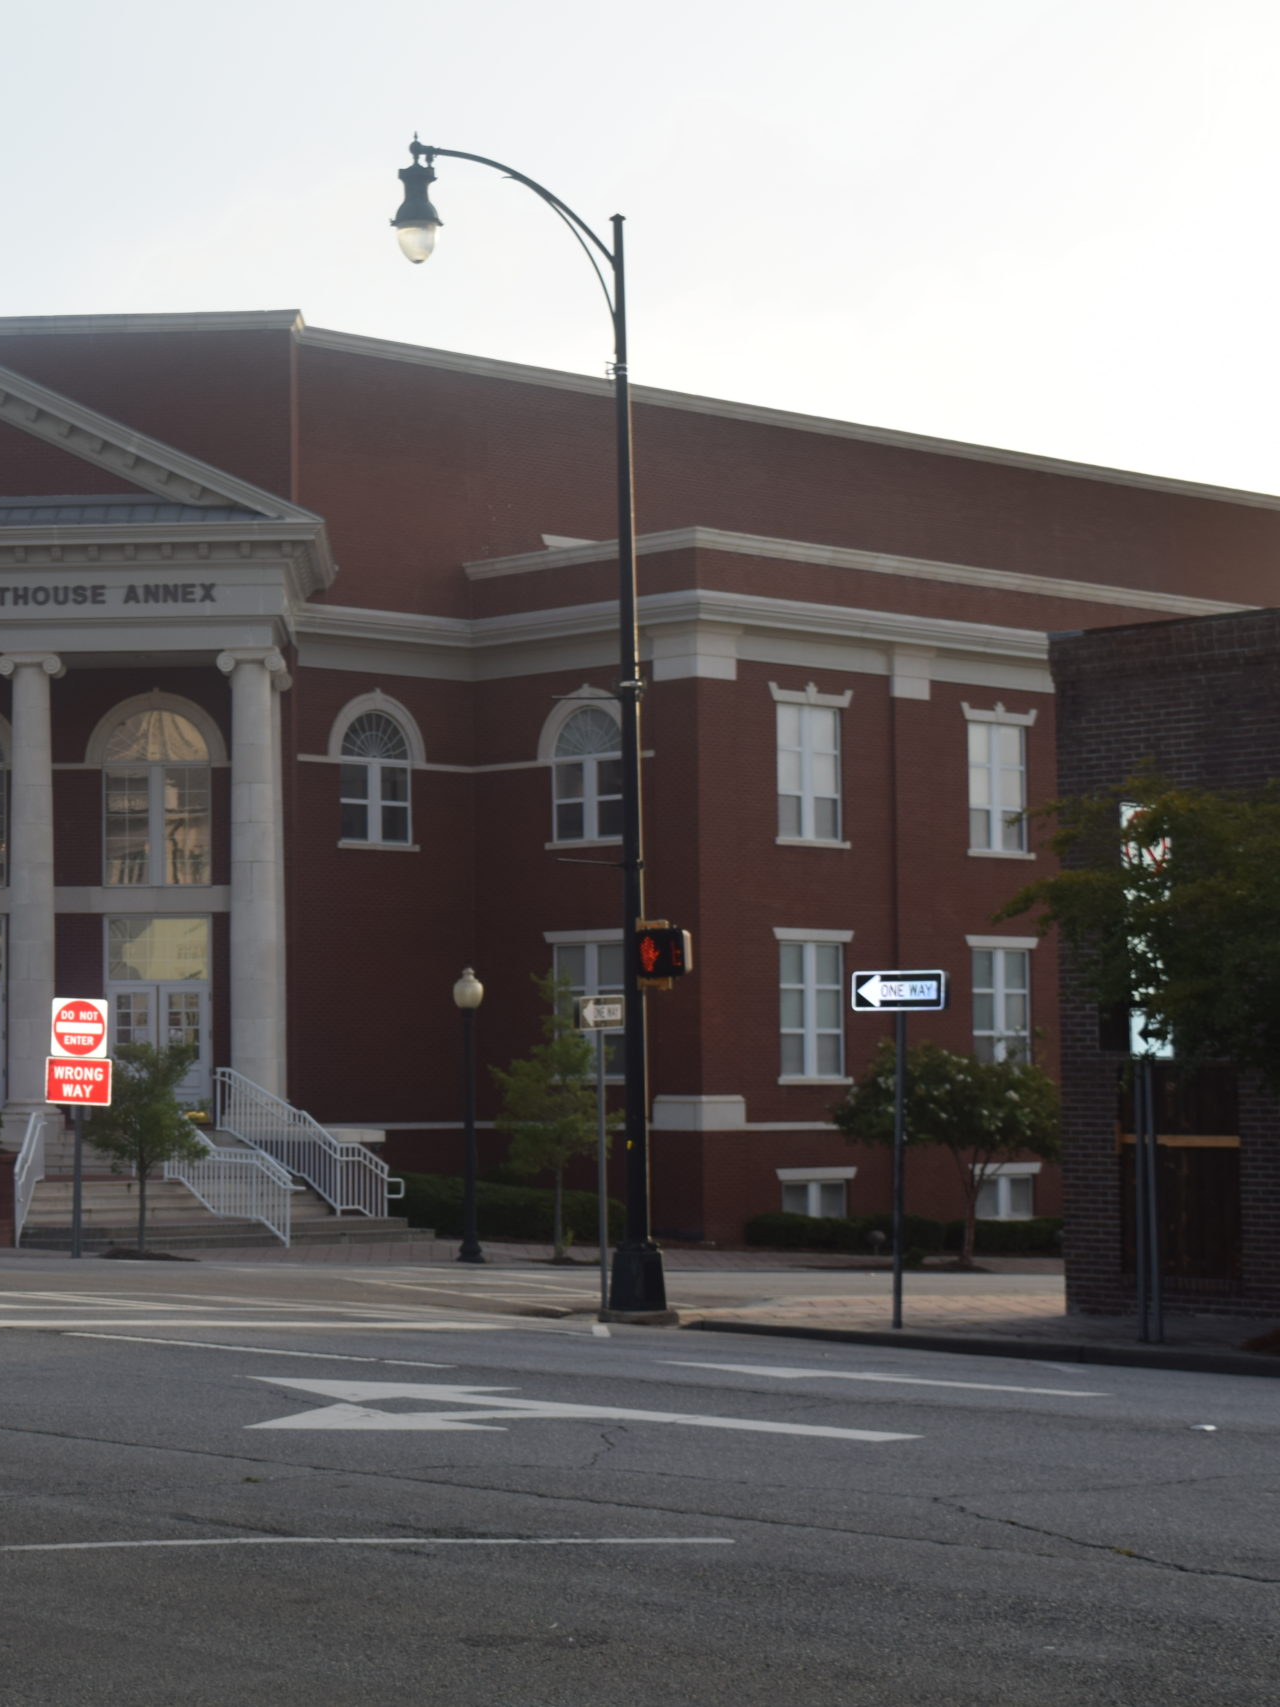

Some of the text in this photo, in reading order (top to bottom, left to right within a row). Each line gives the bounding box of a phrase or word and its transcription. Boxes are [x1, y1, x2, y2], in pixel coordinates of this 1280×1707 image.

[123, 582, 217, 604] ANNEX
[880, 983, 933, 998] ONE WAY
[61, 1010, 98, 1021] DO NOT
[64, 1035, 94, 1046] ENTER
[53, 1066, 104, 1082] WRONG
[62, 1083, 93, 1098] WAY
